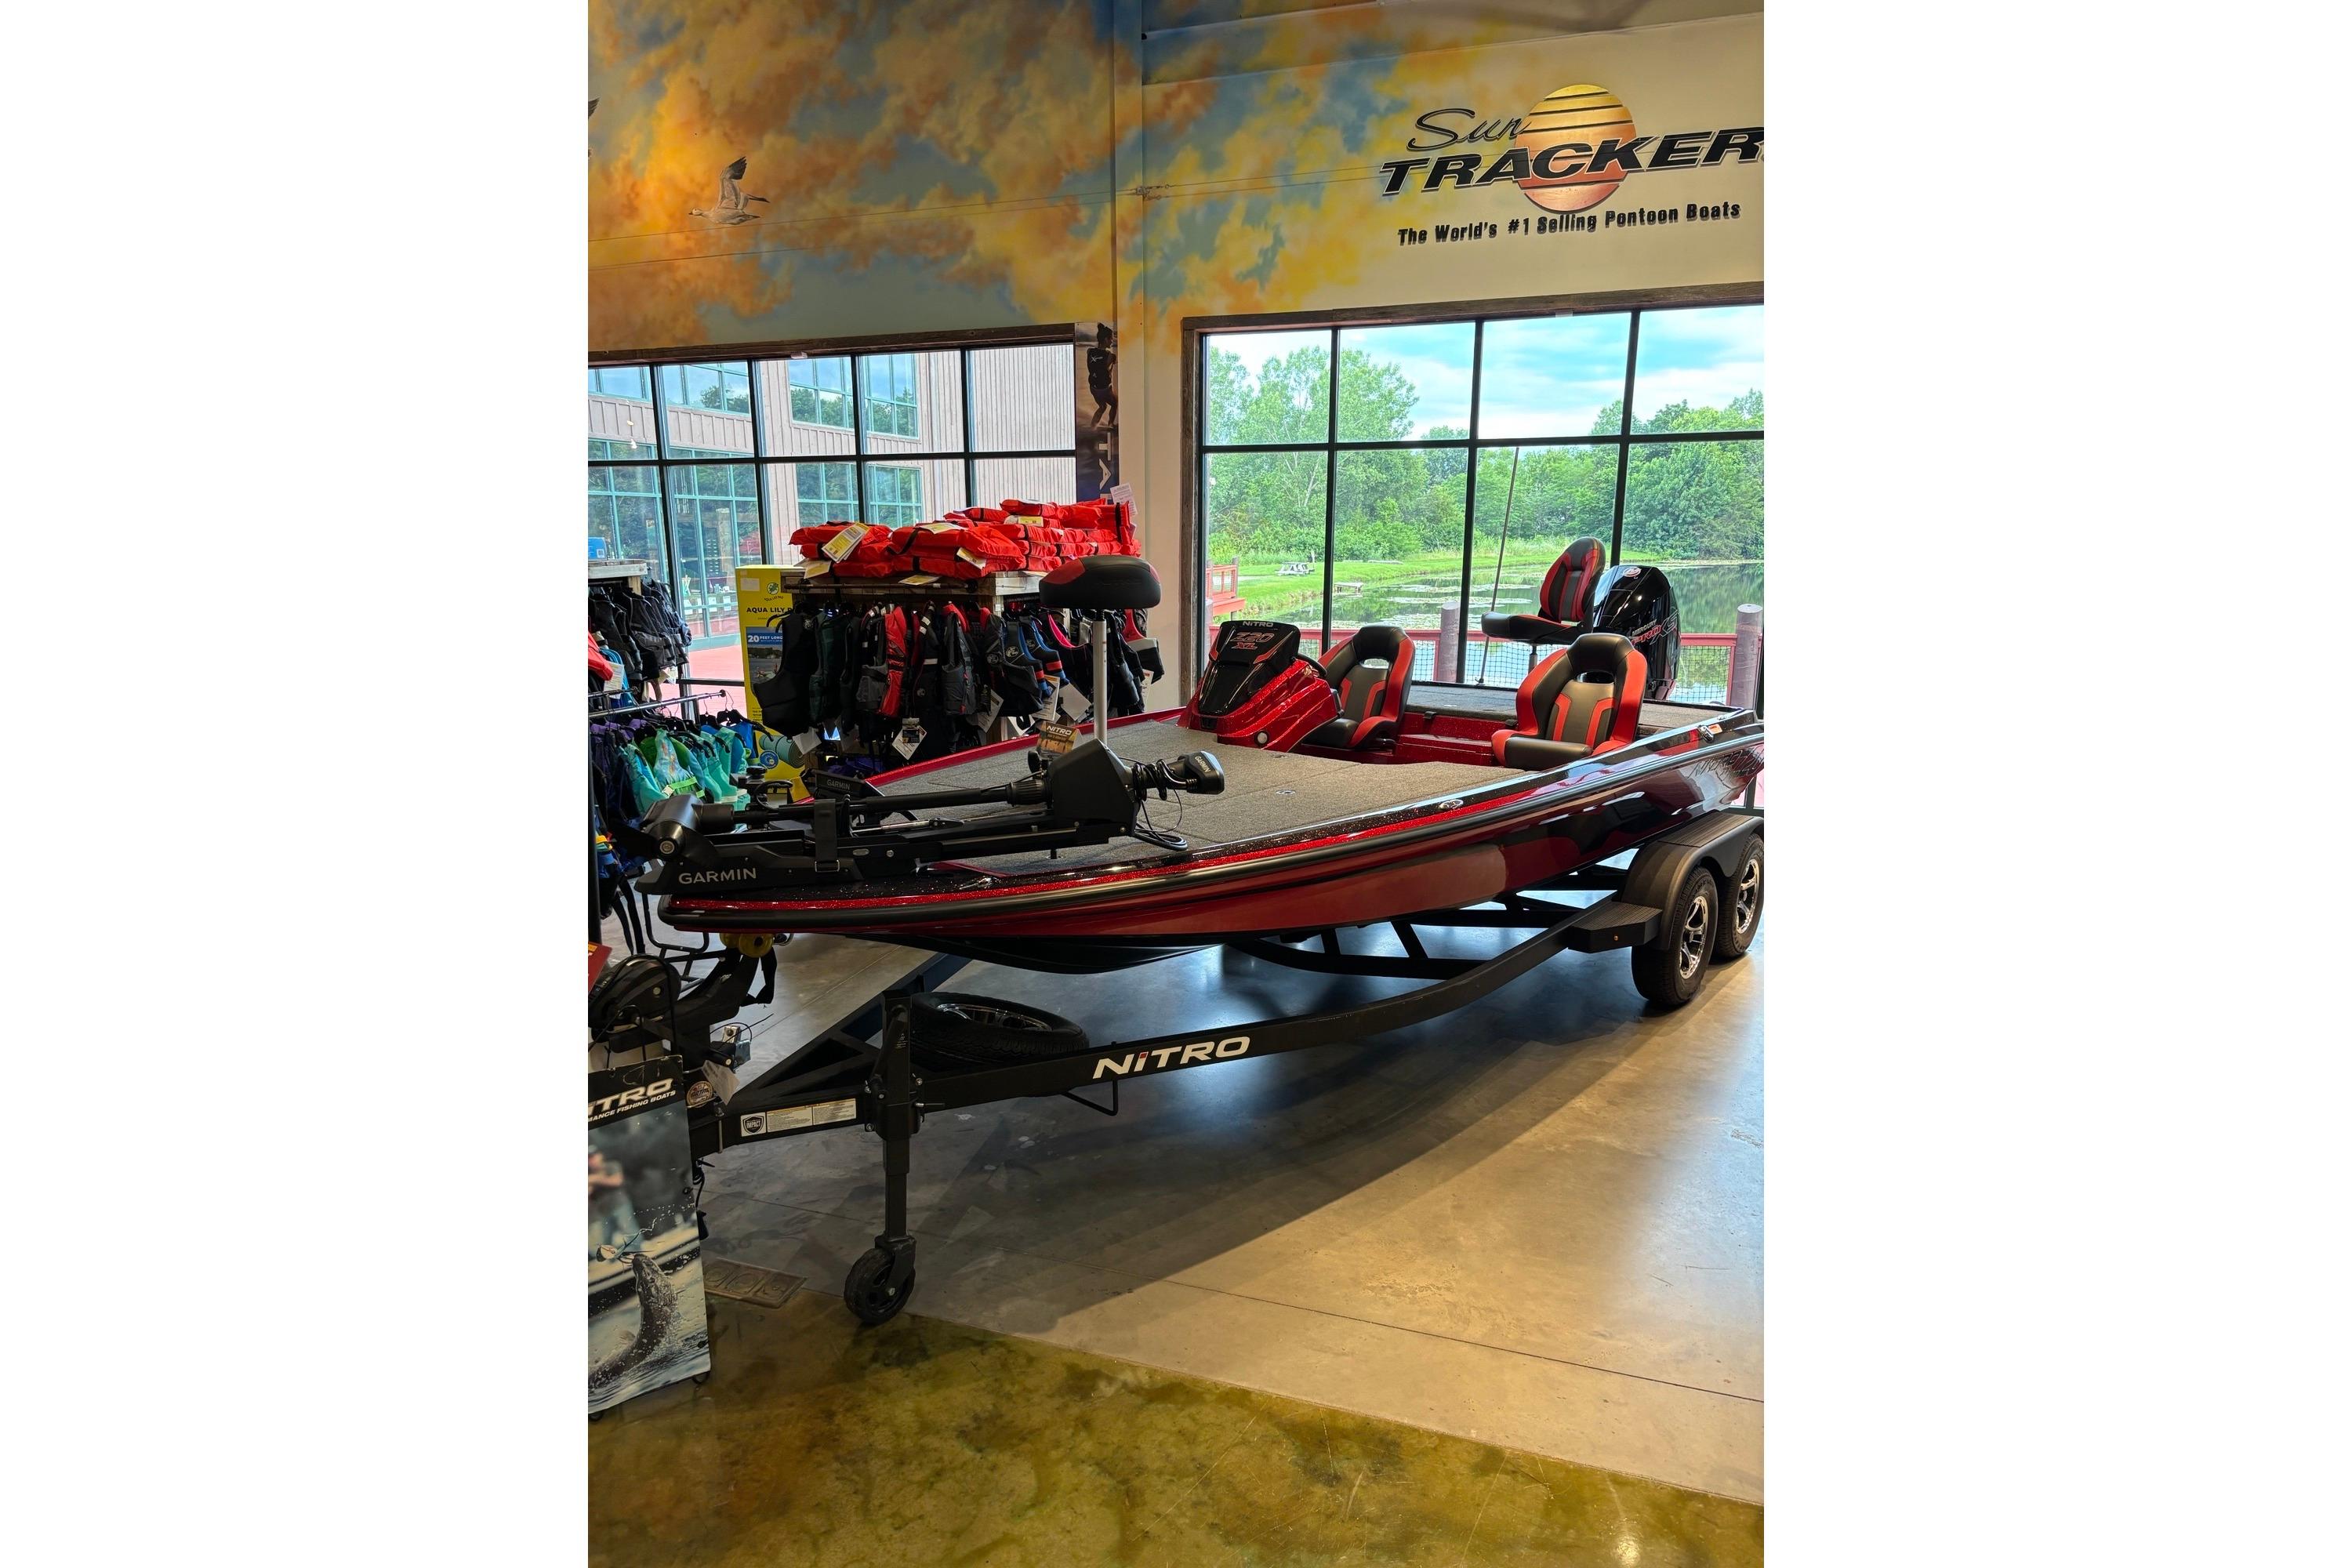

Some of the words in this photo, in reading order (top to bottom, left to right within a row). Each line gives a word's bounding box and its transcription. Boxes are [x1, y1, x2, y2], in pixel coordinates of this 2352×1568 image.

[1406, 107, 1531, 152] Sun
[1380, 126, 1764, 196] TRACKER
[1398, 227, 1428, 245] The
[1435, 222, 1498, 242] World's
[1507, 217, 1530, 235] #1
[1537, 213, 1597, 234] Selling
[1605, 208, 1679, 228] Pontoon
[1686, 201, 1740, 222] Boats
[678, 867, 757, 884] GARMIN
[588, 1109, 616, 1122] MANCE
[617, 1099, 648, 1114] FISHING
[650, 1090, 677, 1103] BOATS
